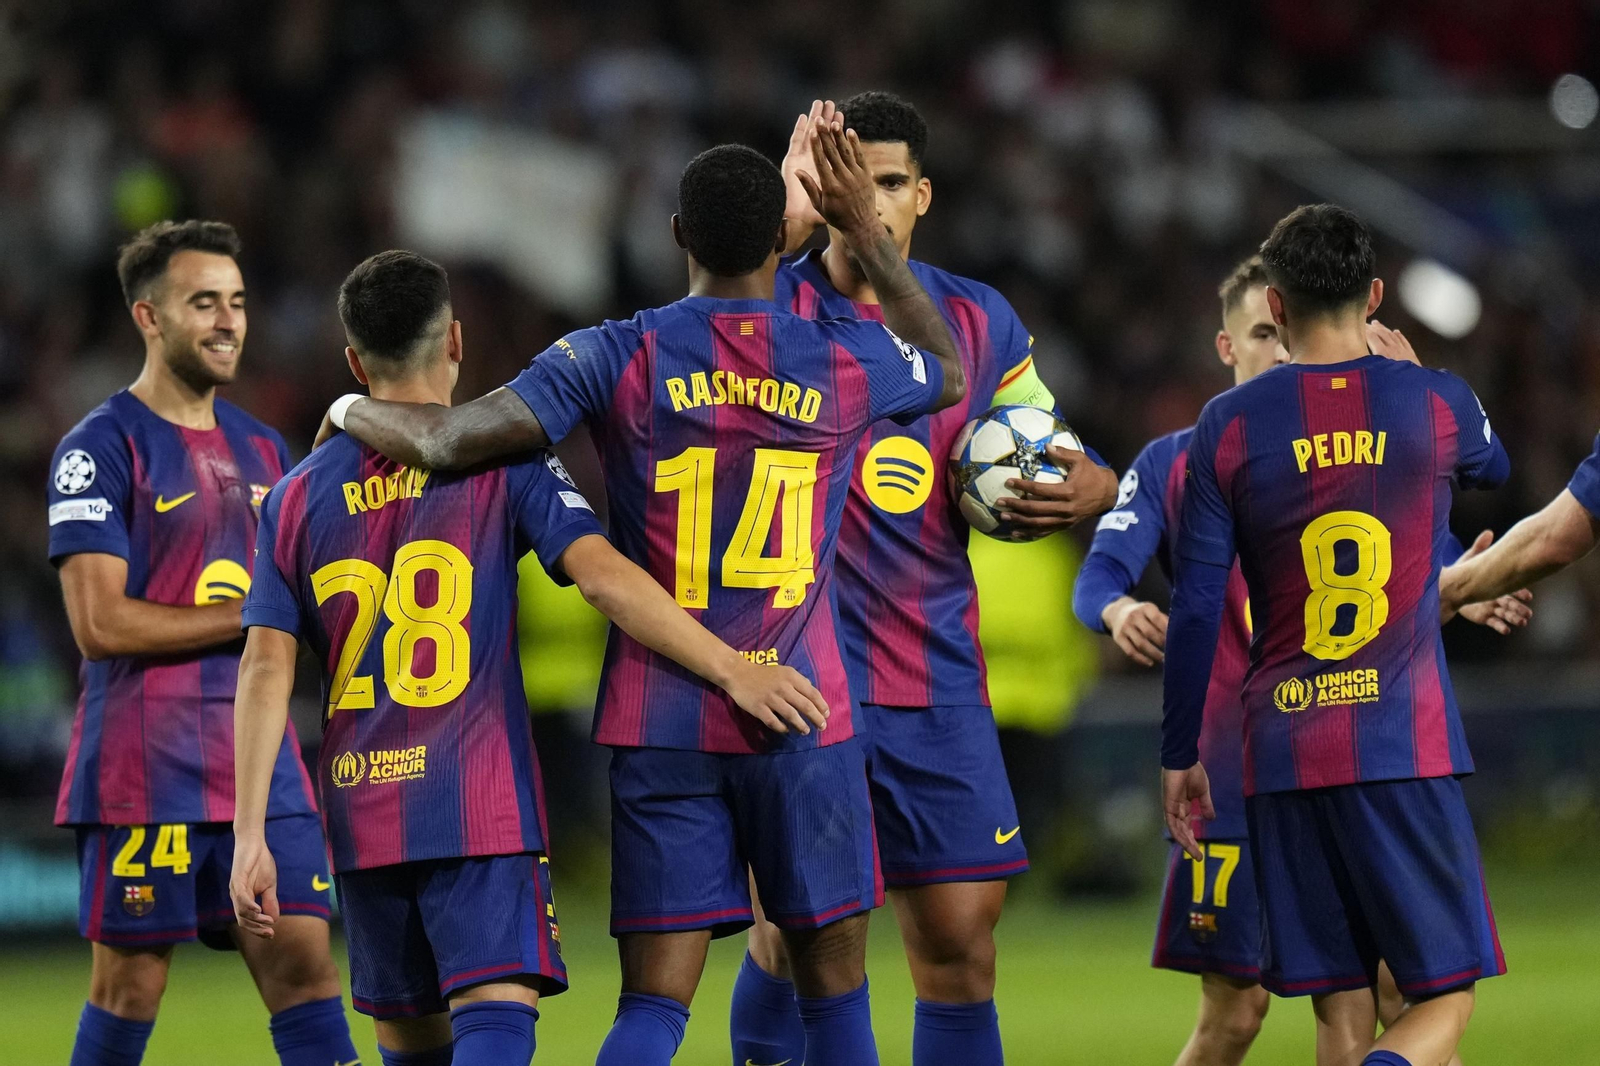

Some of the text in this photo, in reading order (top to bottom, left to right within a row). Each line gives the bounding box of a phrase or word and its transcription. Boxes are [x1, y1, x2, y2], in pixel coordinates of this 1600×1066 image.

[665, 370, 823, 424] RASHFORD
[1291, 430, 1387, 473] PEDRI
[654, 446, 821, 609] 14
[1300, 510, 1392, 661] 8
[310, 539, 474, 720] 28
[739, 647, 779, 664] HCR
[1315, 668, 1378, 689] UNHCR
[1316, 682, 1379, 702] ACNUR
[369, 745, 427, 764] UNHCR
[369, 758, 426, 779] ACNUR
[112, 823, 192, 877] 24
[1183, 843, 1241, 908] 17
